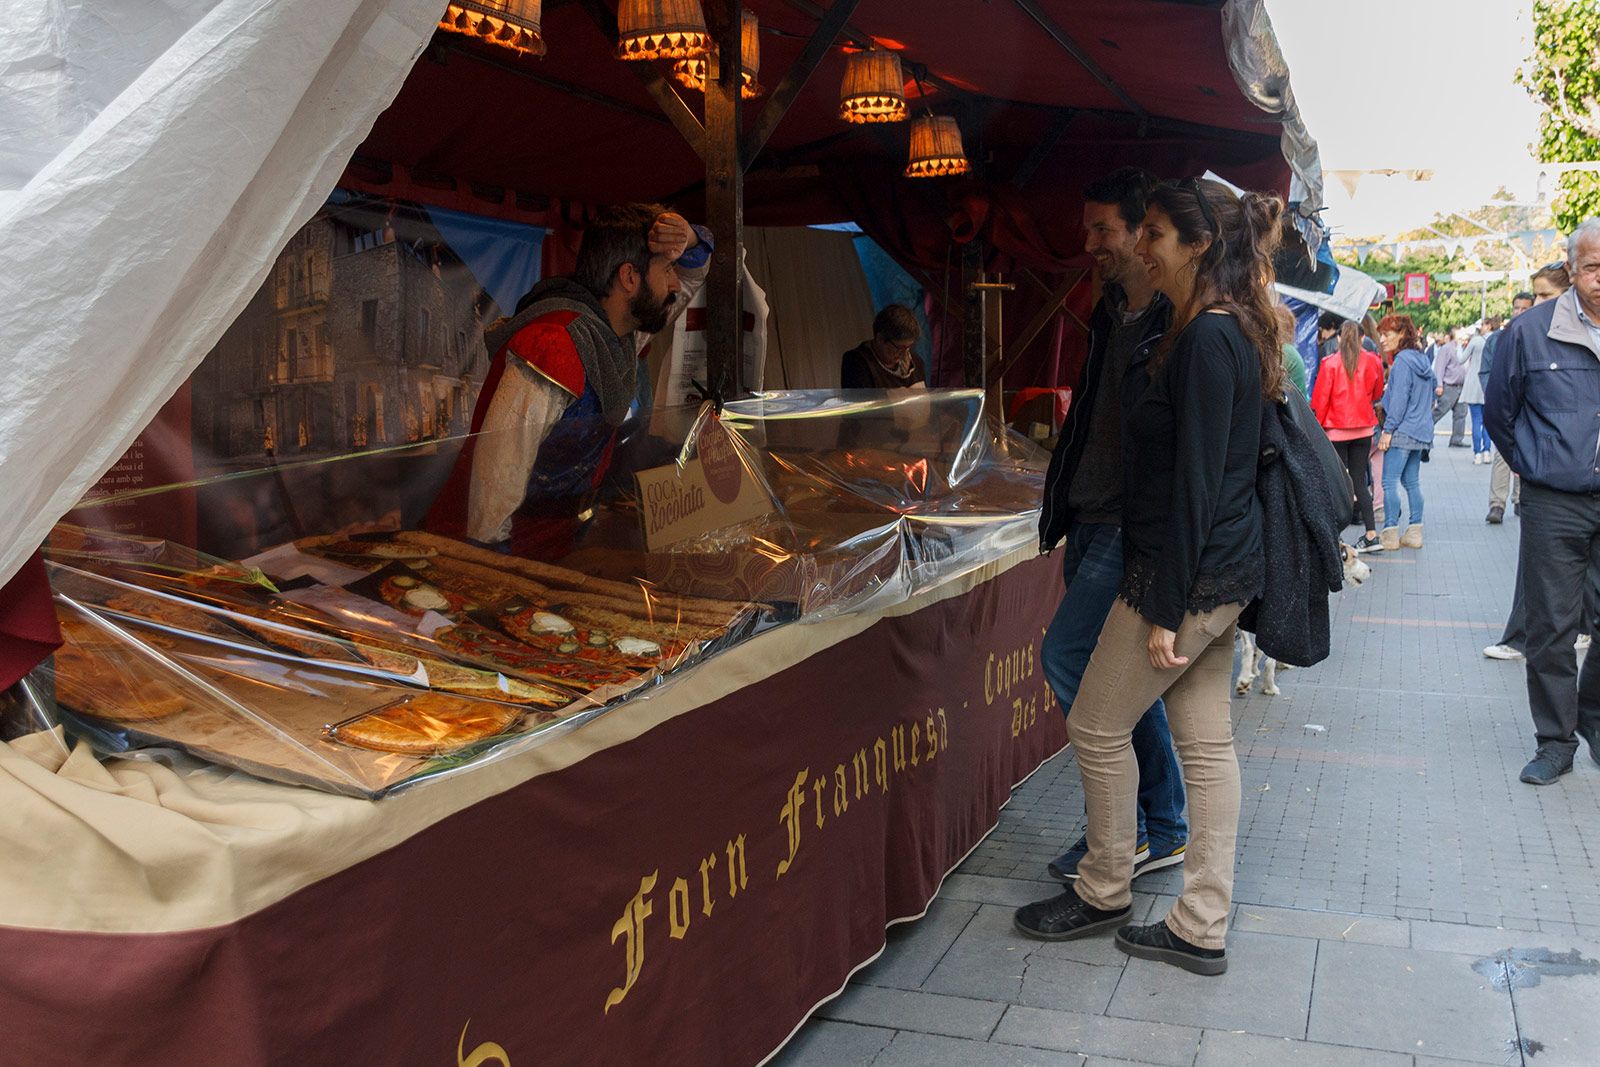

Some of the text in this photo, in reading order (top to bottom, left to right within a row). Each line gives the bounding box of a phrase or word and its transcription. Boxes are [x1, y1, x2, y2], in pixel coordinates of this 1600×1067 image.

[116, 474, 131, 483] amb
[647, 480, 678, 503] COCA
[650, 484, 705, 535] Xocolata
[605, 642, 1034, 1015] Forn Franquesa Coques
